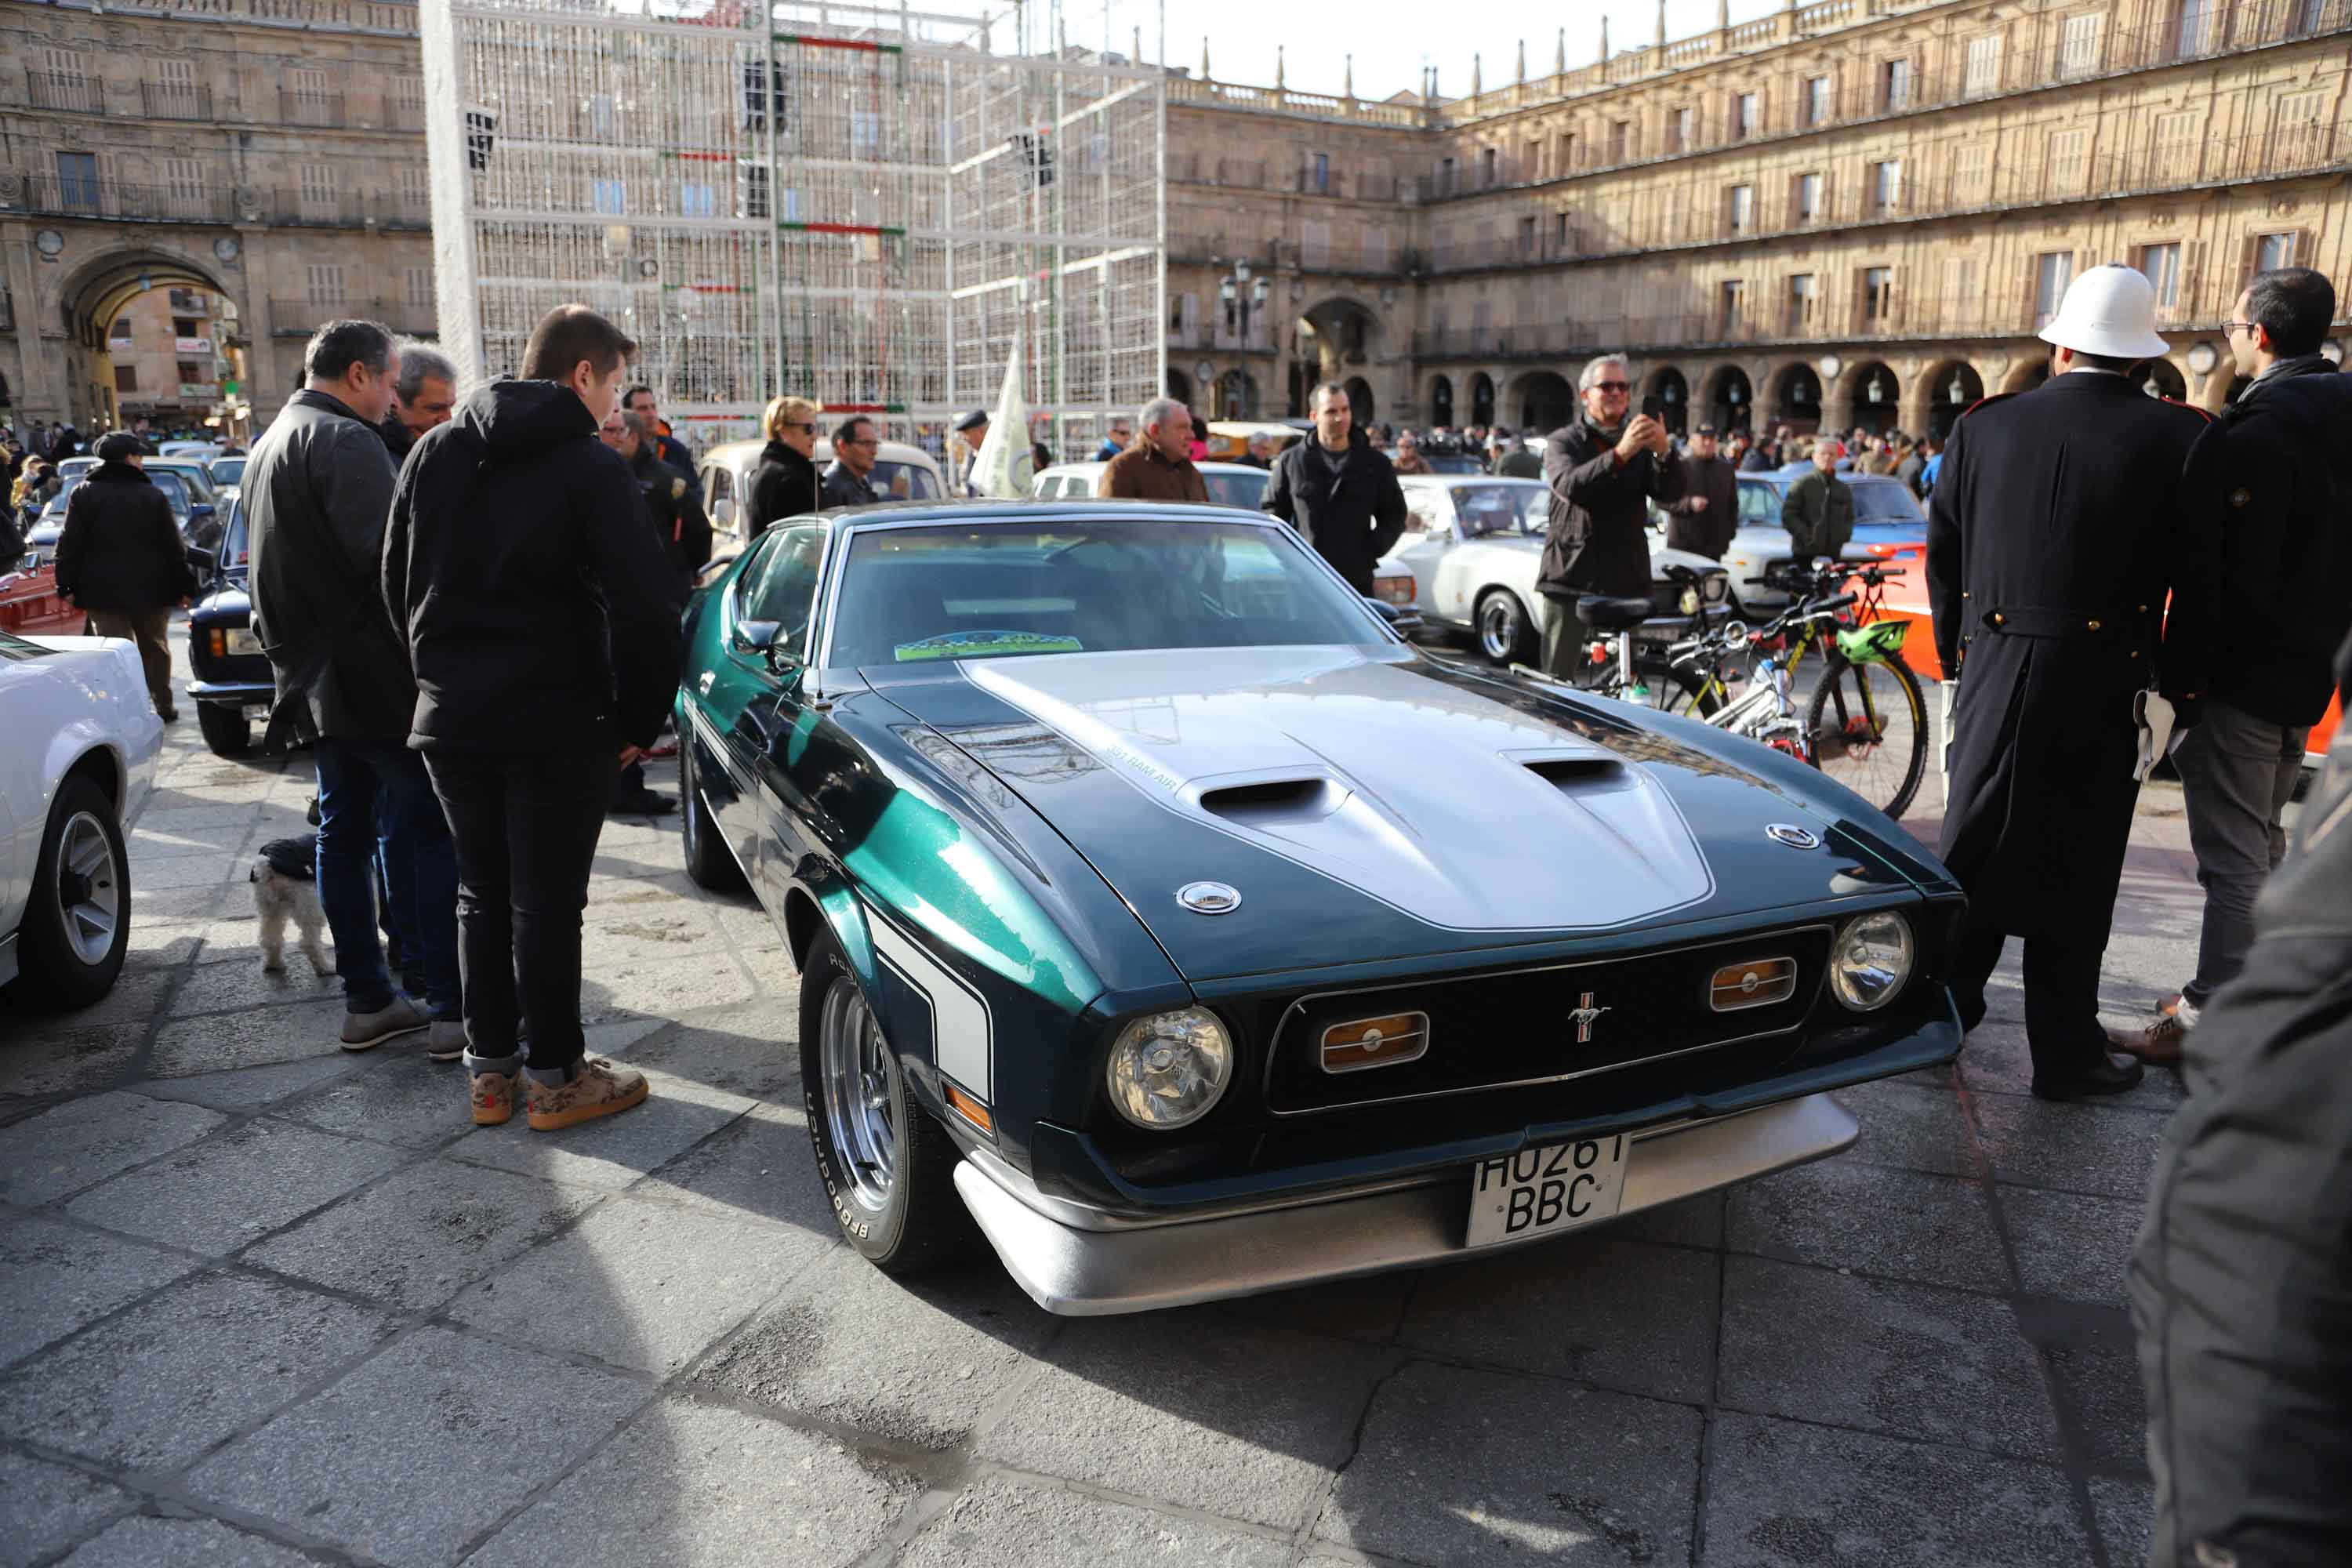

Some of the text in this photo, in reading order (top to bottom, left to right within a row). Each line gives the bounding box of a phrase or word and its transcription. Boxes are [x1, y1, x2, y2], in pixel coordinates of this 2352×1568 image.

[1127, 757, 1156, 777] RAM
[1154, 773, 1178, 790] AIR
[1504, 1173, 1595, 1234] BBC
